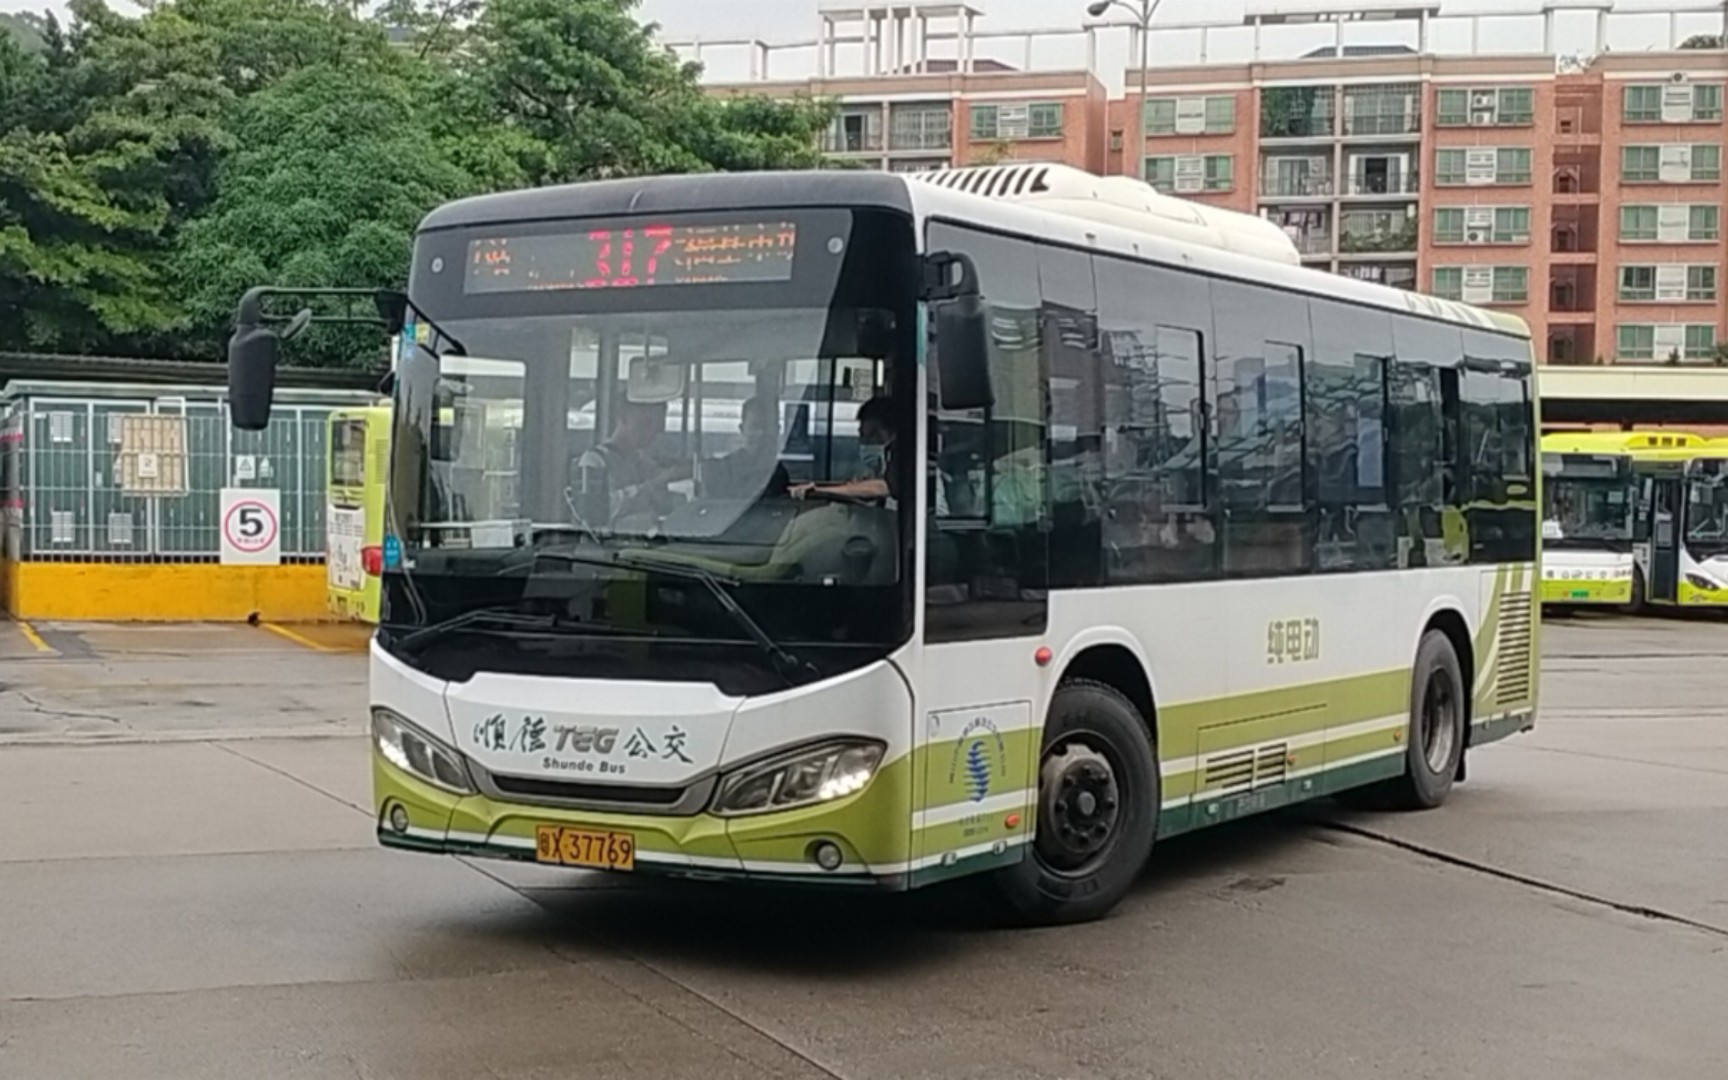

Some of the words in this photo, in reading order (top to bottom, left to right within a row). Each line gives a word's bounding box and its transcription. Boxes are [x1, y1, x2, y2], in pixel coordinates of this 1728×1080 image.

[585, 226, 672, 288] 317
[240, 508, 263, 537] 5
[1267, 617, 1320, 664] 纯电动
[553, 724, 620, 754] TEG
[623, 725, 694, 764] 公交
[543, 757, 593, 772] Shunde
[600, 761, 626, 774] Bus
